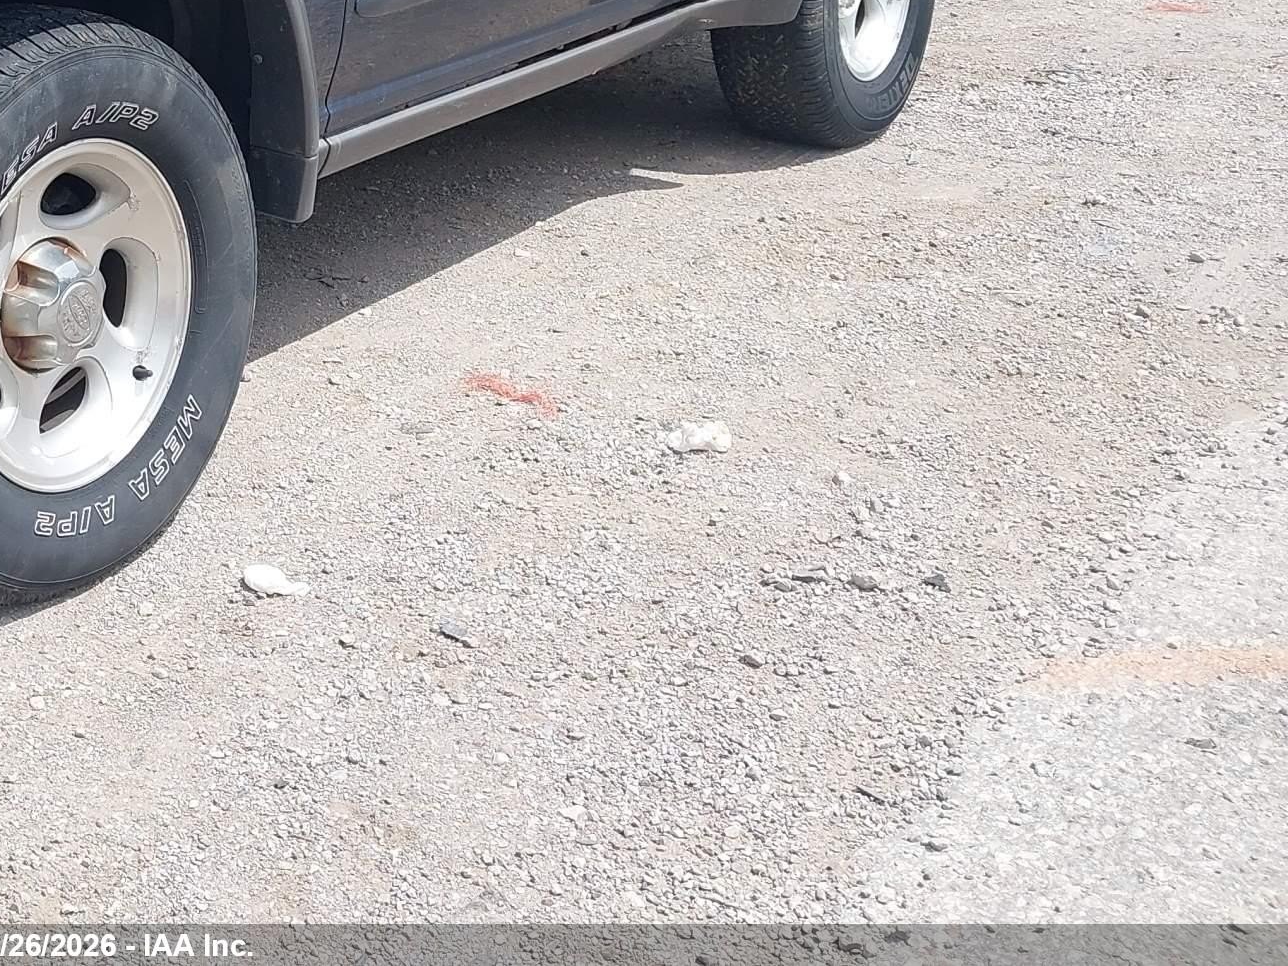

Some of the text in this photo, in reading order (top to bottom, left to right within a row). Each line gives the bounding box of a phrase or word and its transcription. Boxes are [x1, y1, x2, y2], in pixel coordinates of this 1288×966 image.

[72, 101, 159, 131] A/P2
[33, 393, 203, 537] MESA A/P2
